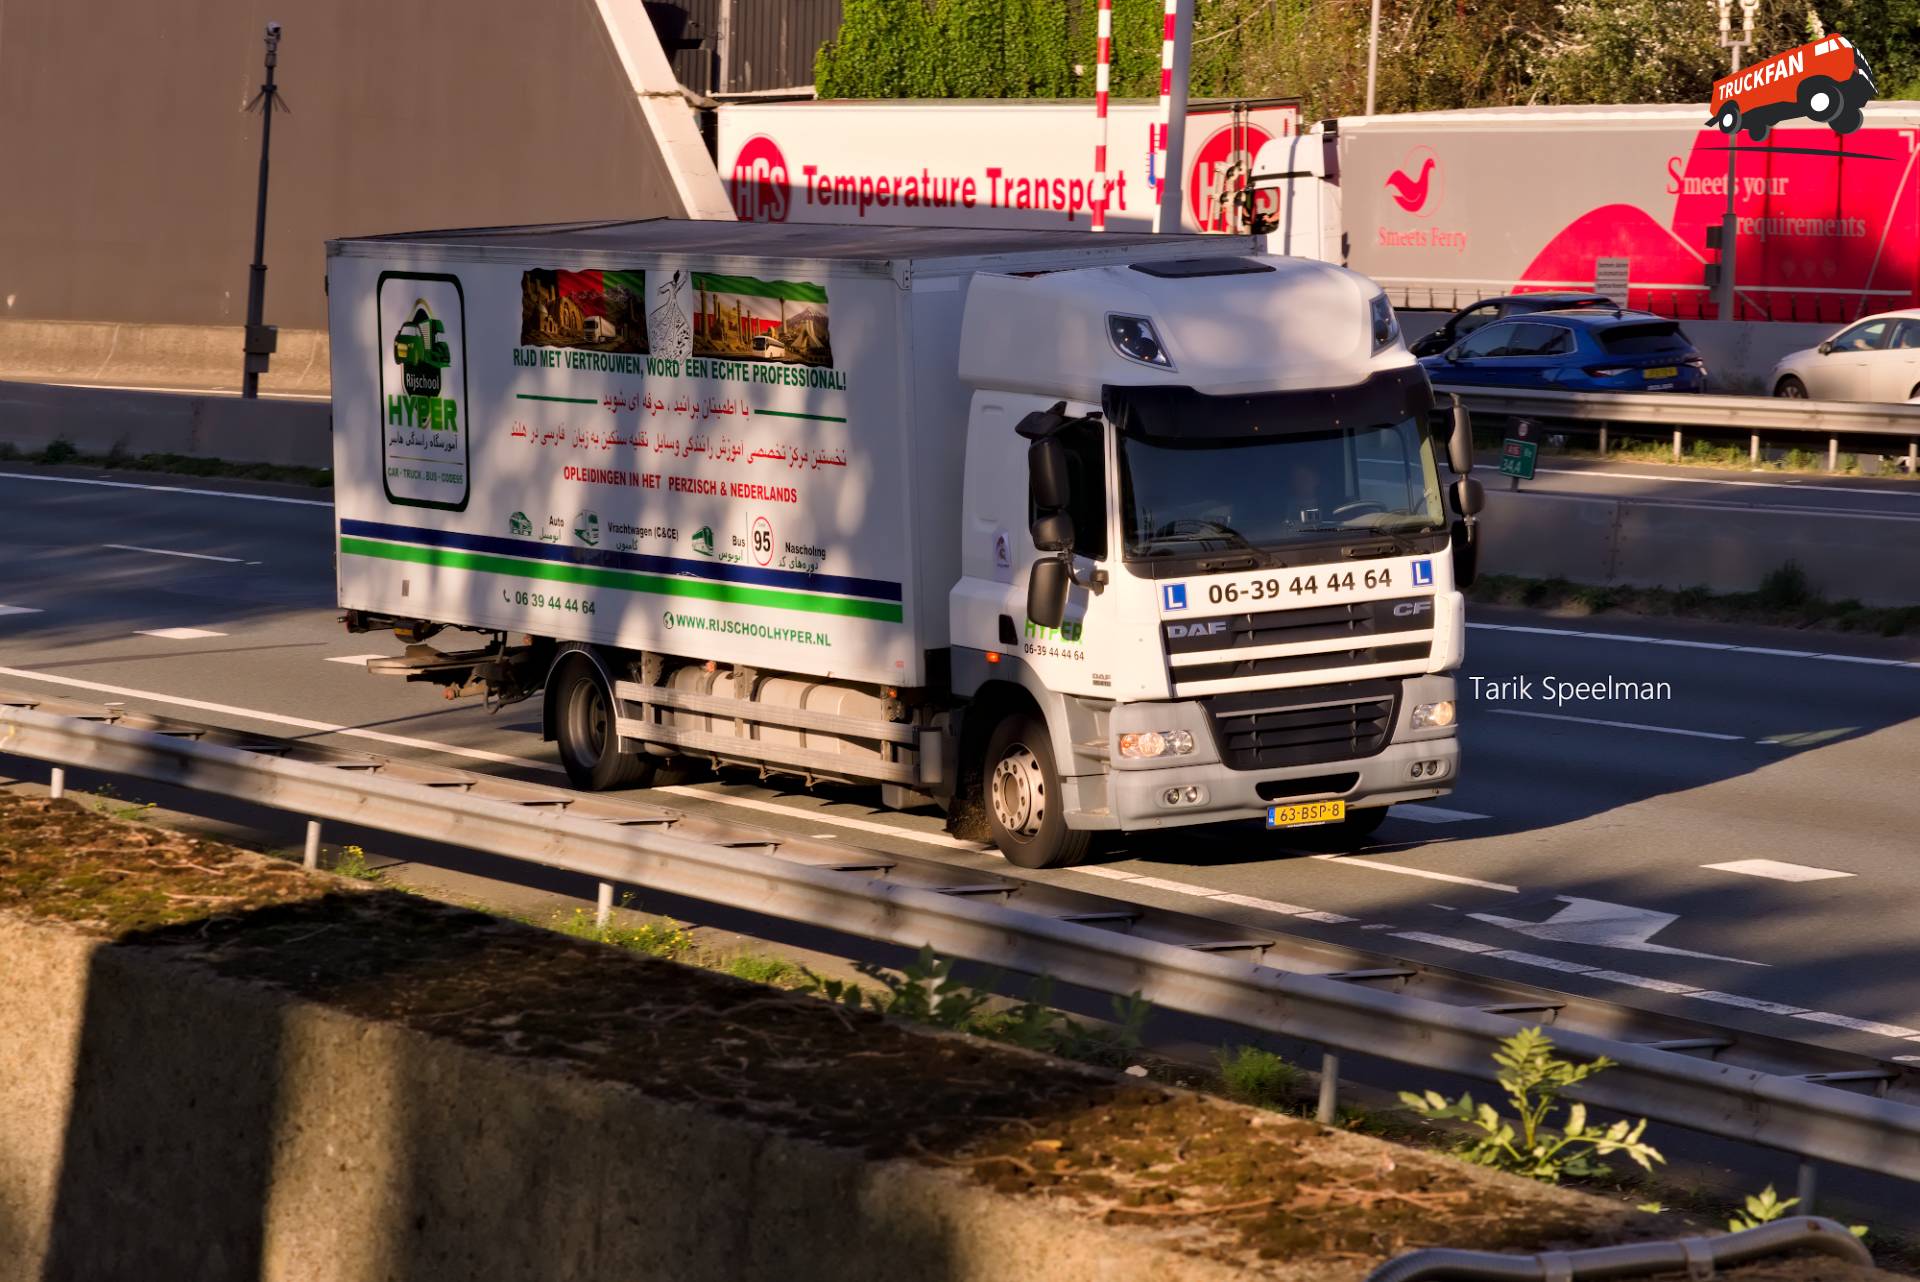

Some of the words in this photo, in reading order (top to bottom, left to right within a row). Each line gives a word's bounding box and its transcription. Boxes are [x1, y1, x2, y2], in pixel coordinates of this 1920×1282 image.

[736, 157, 786, 222] HCS
[802, 165, 977, 218] Temperature
[1742, 177, 1790, 203] your
[1736, 211, 1867, 242] requirements
[1378, 226, 1427, 247] Smeets
[1430, 226, 1467, 256] Ferry
[406, 373, 439, 390] Rijschool
[513, 349, 537, 367] RIJD
[540, 350, 561, 368] MET
[565, 352, 644, 379] VERTROUWEN,
[646, 358, 680, 378] WORD
[685, 359, 708, 378] EEN
[712, 360, 749, 382] ECHTE
[753, 364, 847, 391] PROFESSIONAL!
[387, 394, 458, 432] HYPER
[387, 467, 399, 477] CAR
[564, 466, 626, 486] OPLEIDINGEN
[629, 471, 639, 487] IN
[642, 473, 661, 489] HET
[668, 476, 717, 496] PERZISCH
[720, 481, 728, 496] &
[730, 482, 797, 503] NEDERLANDS
[549, 514, 565, 528] Auto
[607, 521, 653, 540] Vrachtwagen
[654, 526, 679, 541] (C&CE)
[732, 535, 746, 548] Bus
[754, 530, 771, 552] 95
[785, 542, 827, 560] Nascholing
[1414, 561, 1432, 585] L
[1167, 585, 1184, 609] L
[1208, 578, 1280, 604] 06-39
[1288, 575, 1318, 596] 44
[1327, 571, 1356, 592] 44
[1364, 567, 1392, 588] 64
[515, 591, 529, 606] 06
[531, 593, 545, 608] 39
[548, 596, 561, 610] 44
[564, 598, 579, 613] 44
[582, 600, 596, 615] 64
[1393, 601, 1432, 617] CF
[676, 614, 832, 647] WWW.RIJSCHOOLHYPER.NL
[1167, 621, 1227, 639] DAF
[1024, 642, 1047, 656] 06-39
[1049, 647, 1059, 659] 44
[1061, 649, 1072, 659] 44
[1073, 650, 1084, 661] 64
[1280, 803, 1340, 822] 63-BSP-8
